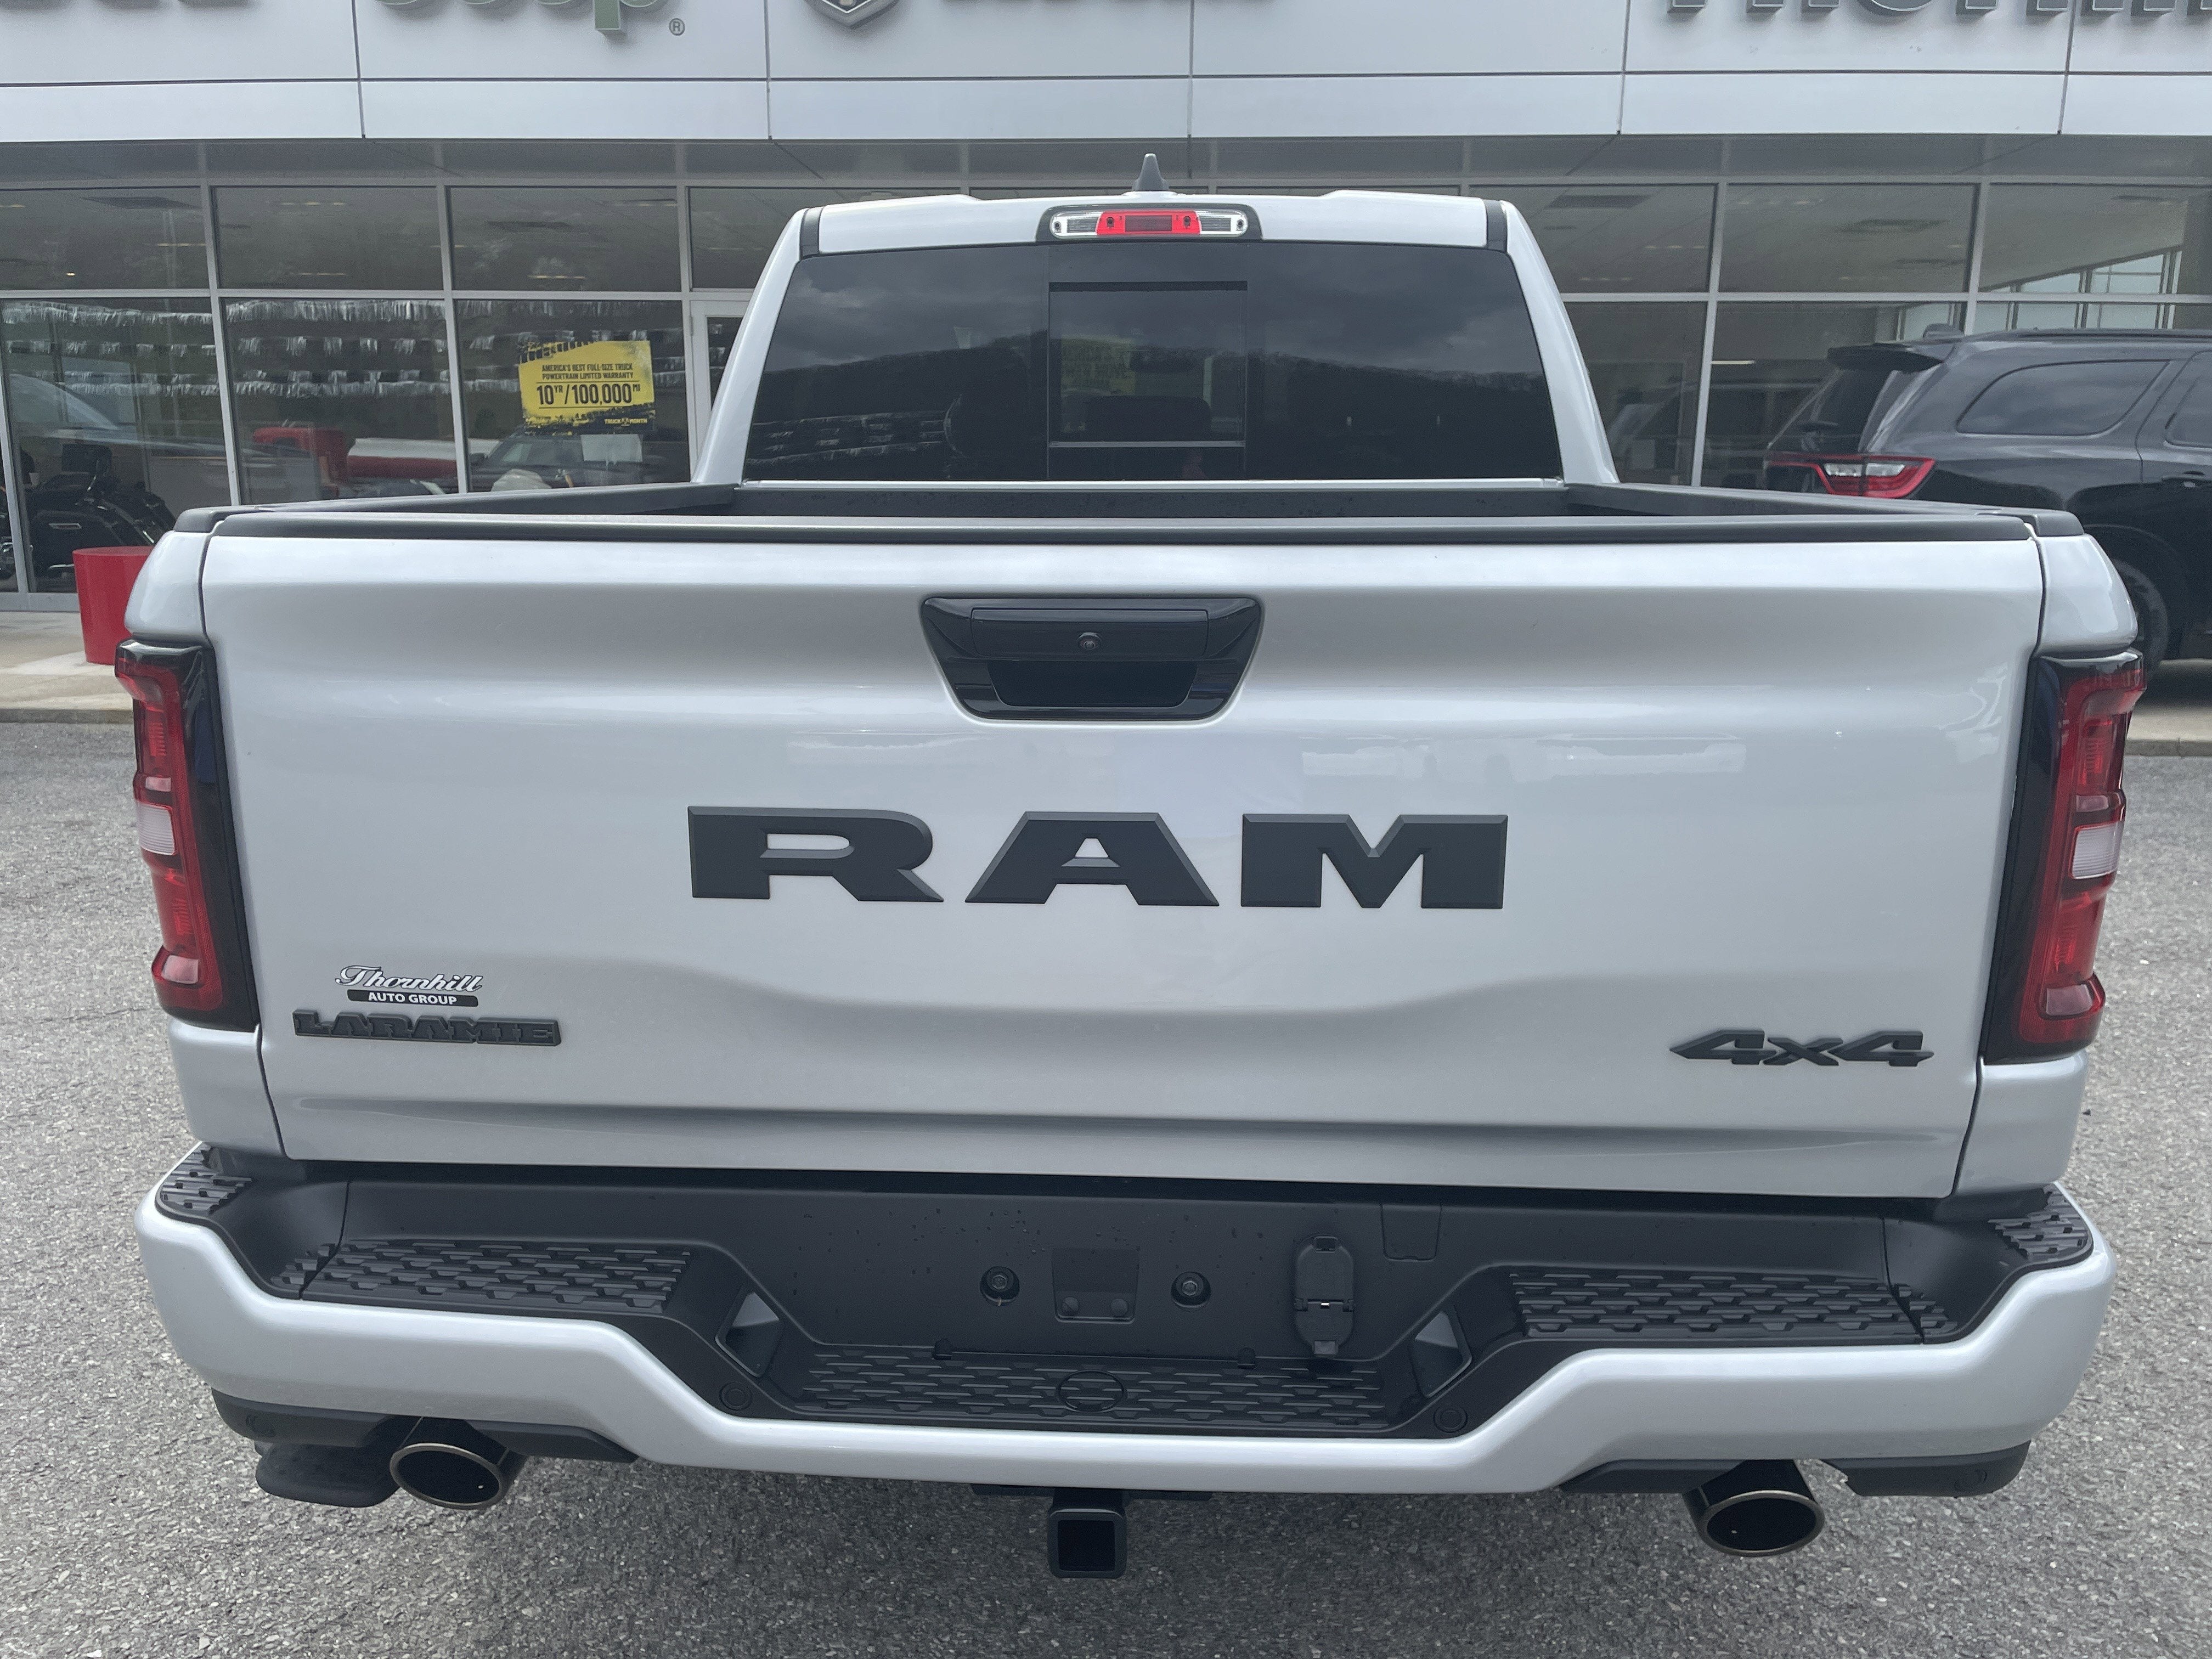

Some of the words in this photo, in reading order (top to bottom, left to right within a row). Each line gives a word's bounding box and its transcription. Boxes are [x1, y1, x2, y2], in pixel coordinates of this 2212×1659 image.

[687, 805, 1509, 909] RAM
[335, 964, 483, 992] Thornhill
[368, 991, 406, 1002] AUTO
[408, 994, 458, 1006] GROUP
[292, 1008, 562, 1046] LARAMIE
